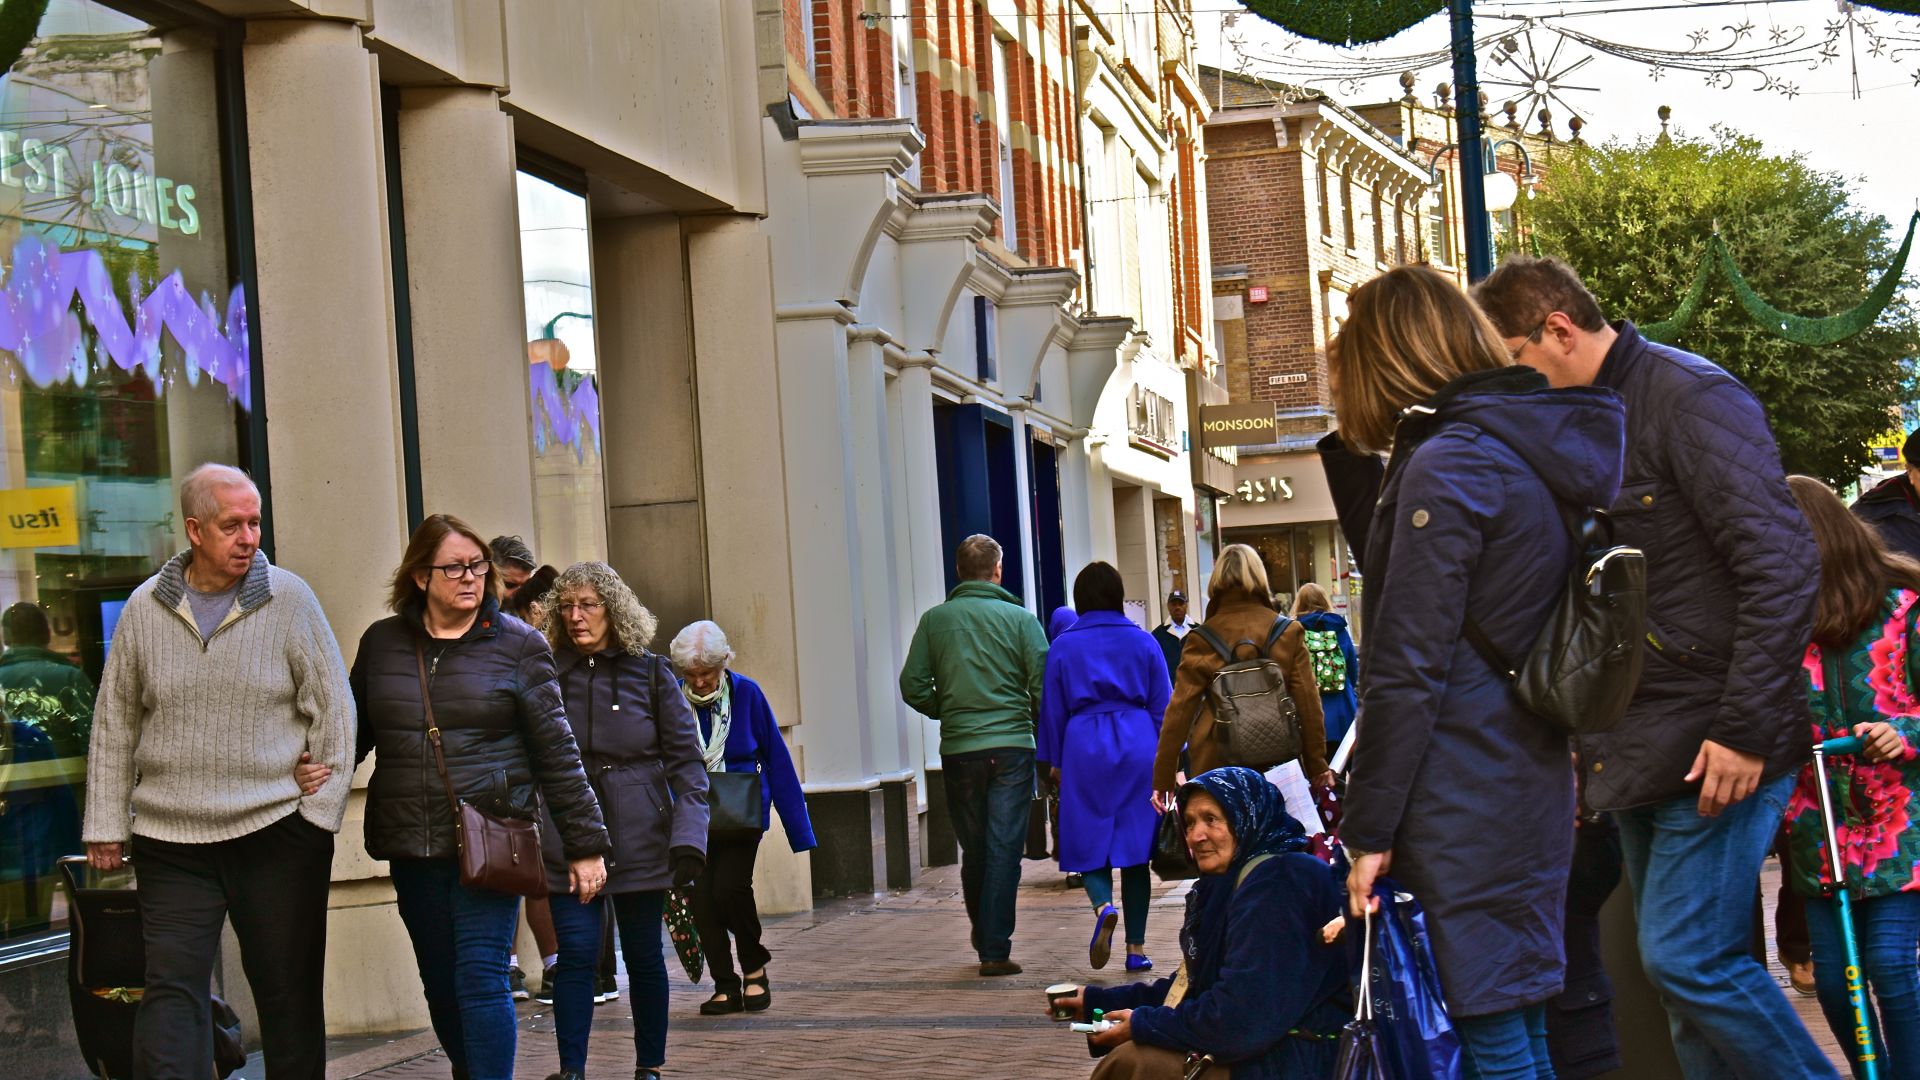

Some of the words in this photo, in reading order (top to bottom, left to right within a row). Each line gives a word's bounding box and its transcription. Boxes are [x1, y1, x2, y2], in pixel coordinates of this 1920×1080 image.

[92, 160, 199, 235] JONES
[1287, 374, 1304, 383] ROAD
[1203, 418, 1274, 432] MONSOON
[1218, 476, 1293, 504] asis
